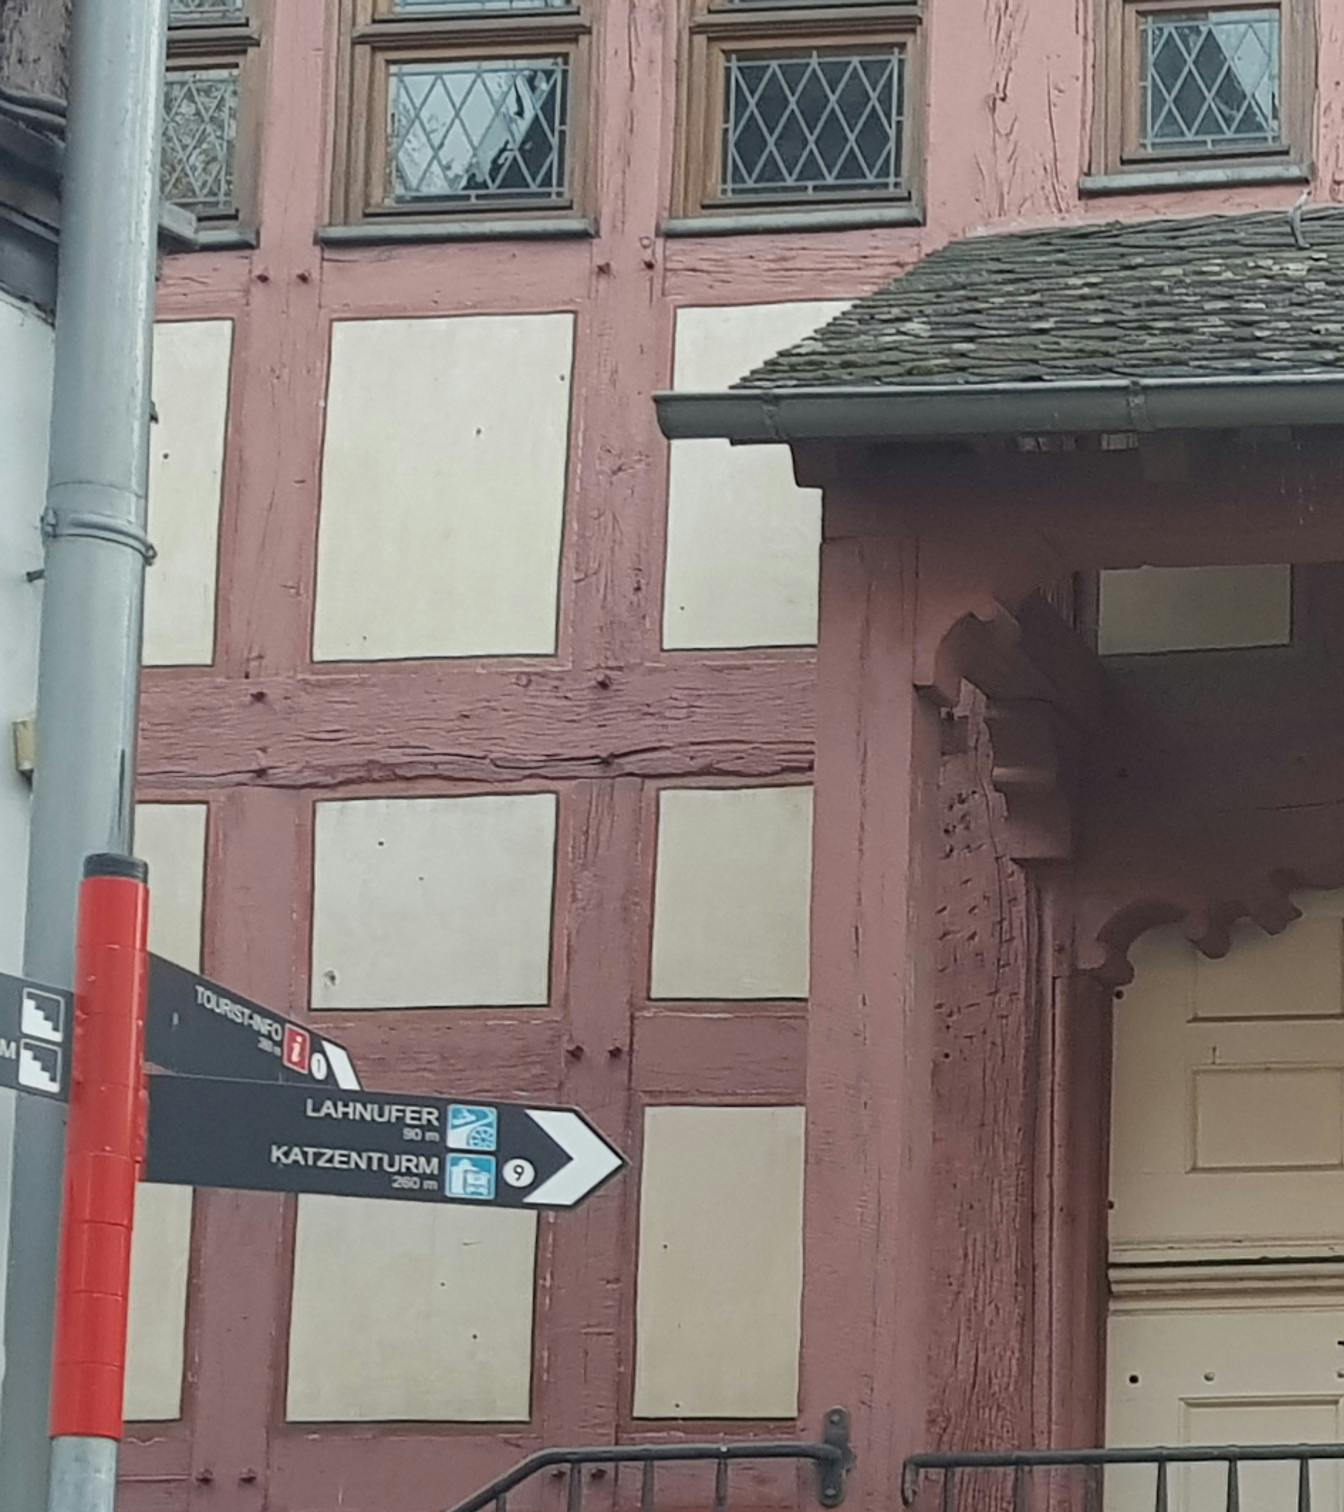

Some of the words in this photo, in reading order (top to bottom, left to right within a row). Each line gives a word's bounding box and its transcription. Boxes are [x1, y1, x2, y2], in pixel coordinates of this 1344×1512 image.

[195, 985, 283, 1042] TOURIST-INFO
[305, 1098, 440, 1127] LAHNUFER
[424, 1131, 440, 1142] m
[270, 1144, 439, 1175] KATZENTURM
[512, 1163, 525, 1181] 9
